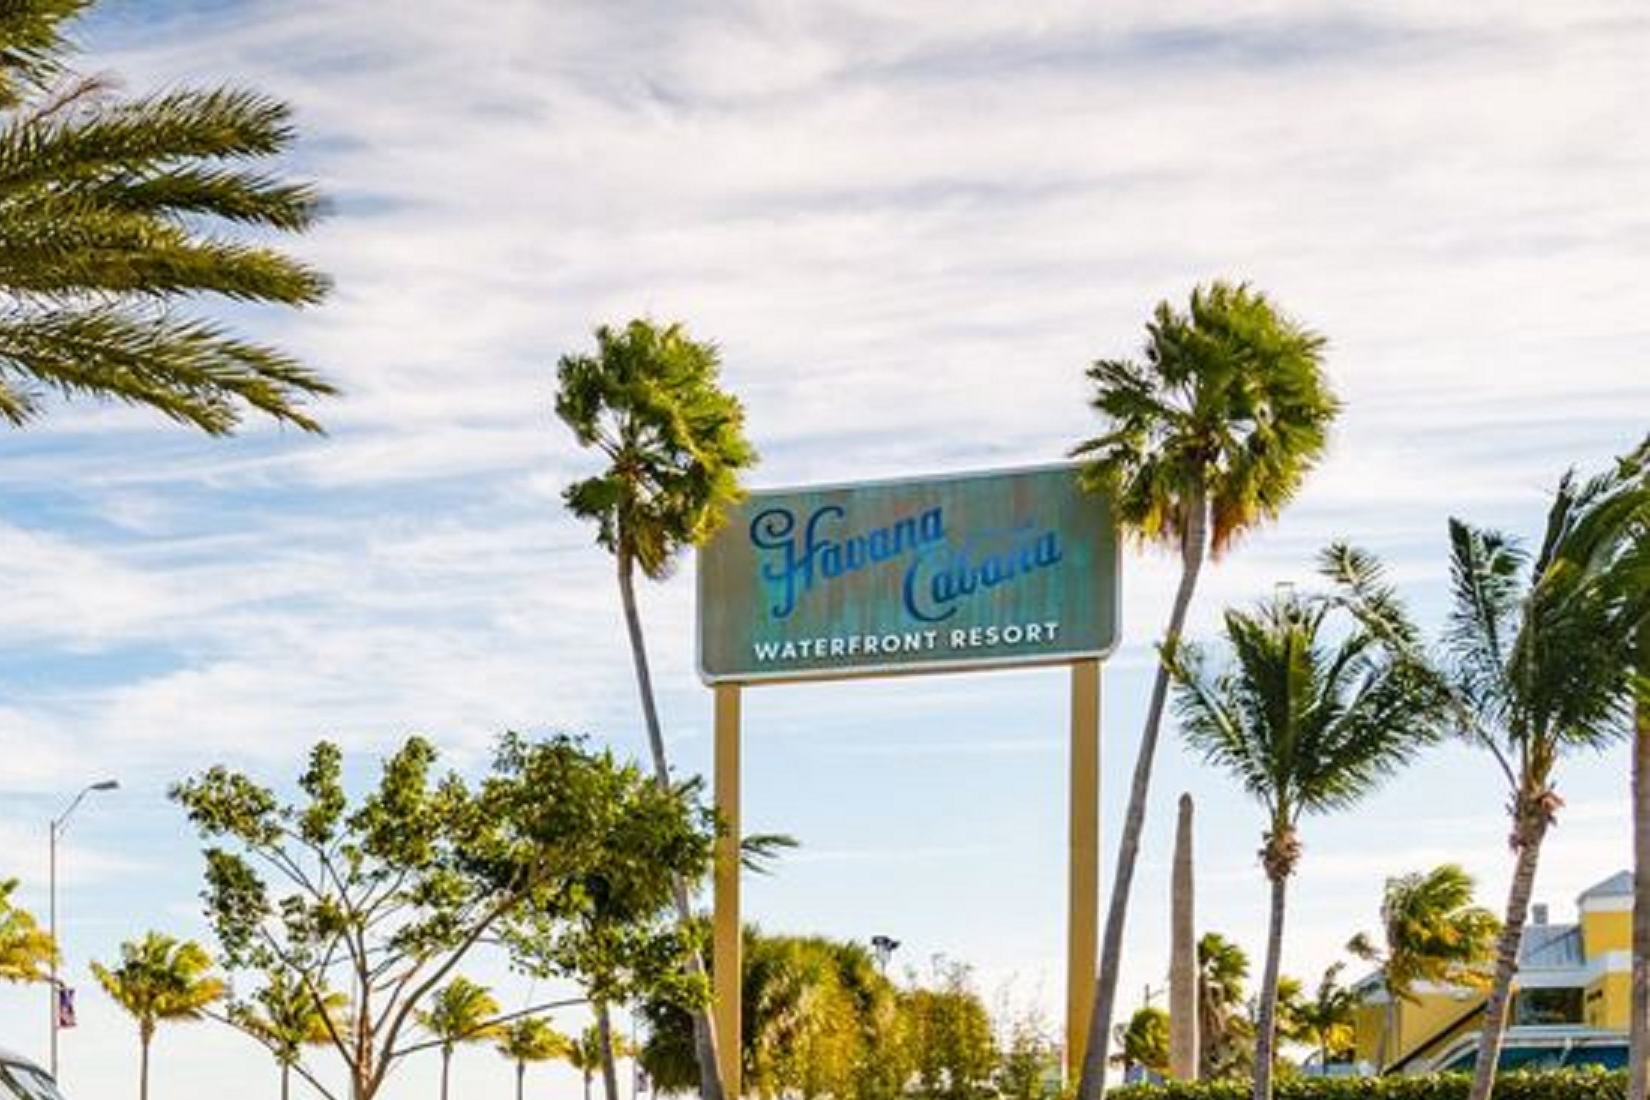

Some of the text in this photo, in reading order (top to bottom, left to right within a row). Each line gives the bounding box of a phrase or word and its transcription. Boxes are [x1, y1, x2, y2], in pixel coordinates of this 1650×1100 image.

[750, 505, 944, 619] Havana
[903, 525, 1063, 622] Cabana
[754, 621, 1059, 662] WATERFRONT RESORT
